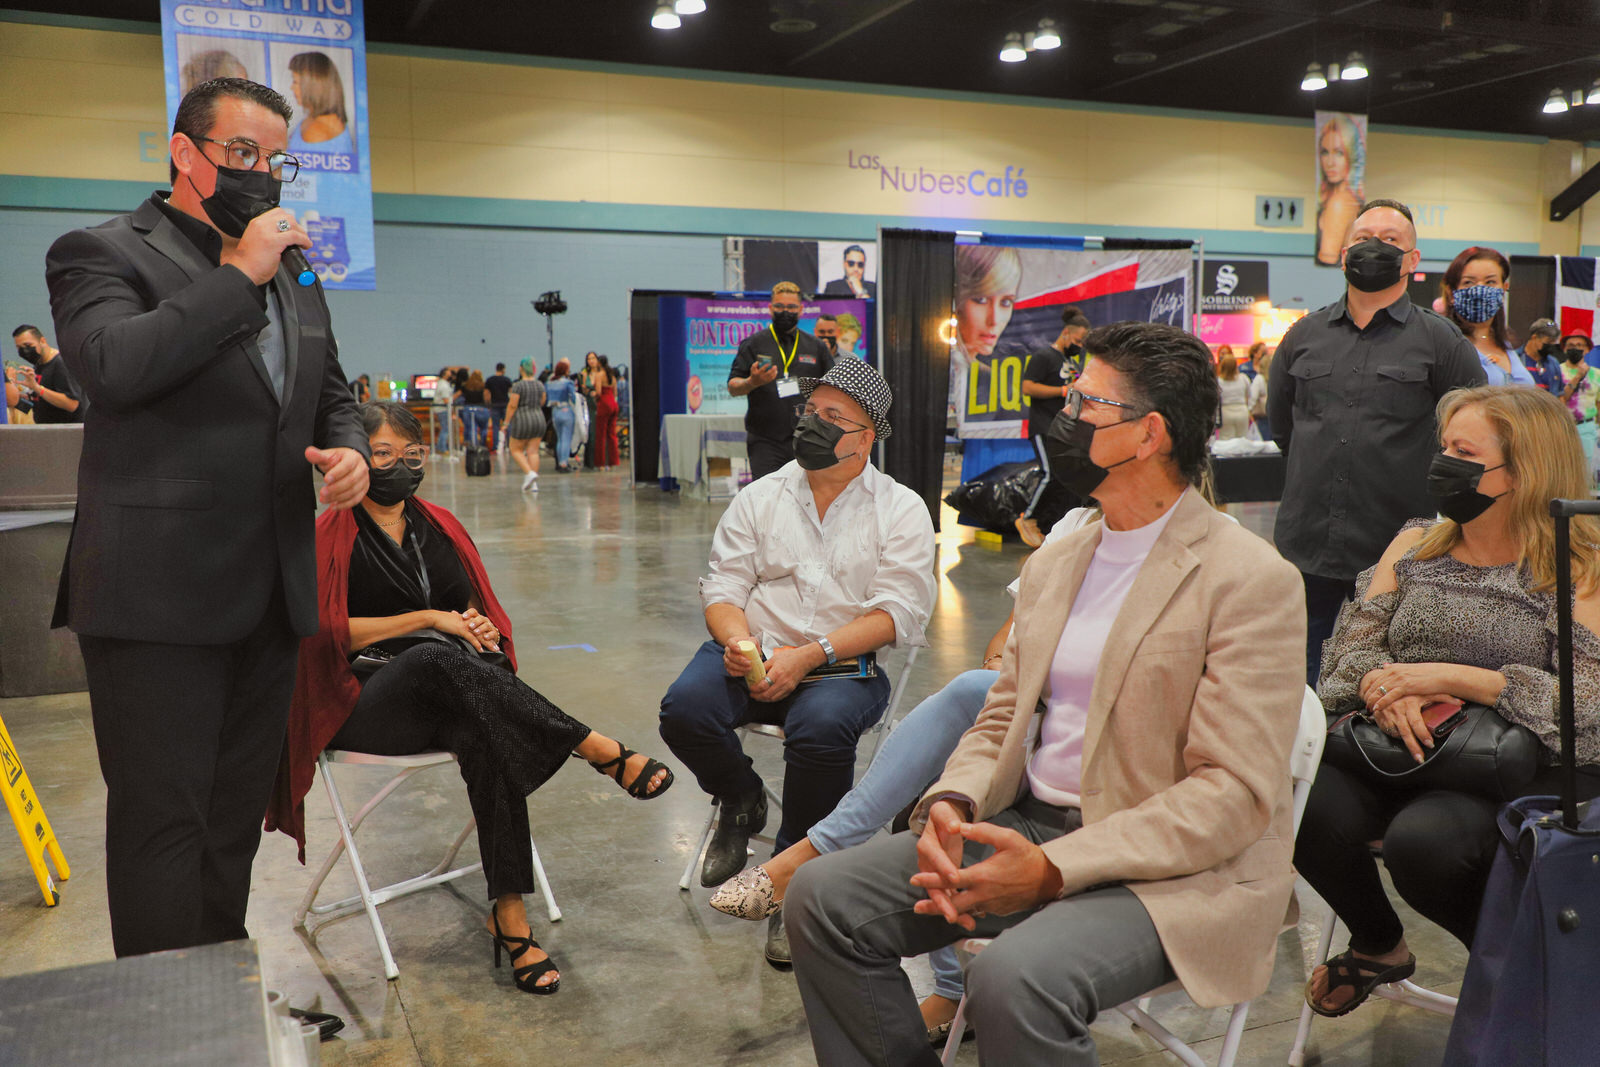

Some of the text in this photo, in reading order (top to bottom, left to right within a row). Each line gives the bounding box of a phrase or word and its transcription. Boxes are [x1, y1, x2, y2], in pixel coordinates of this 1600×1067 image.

[183, 8, 346, 36] COLD WAX
[849, 150, 880, 170] Las
